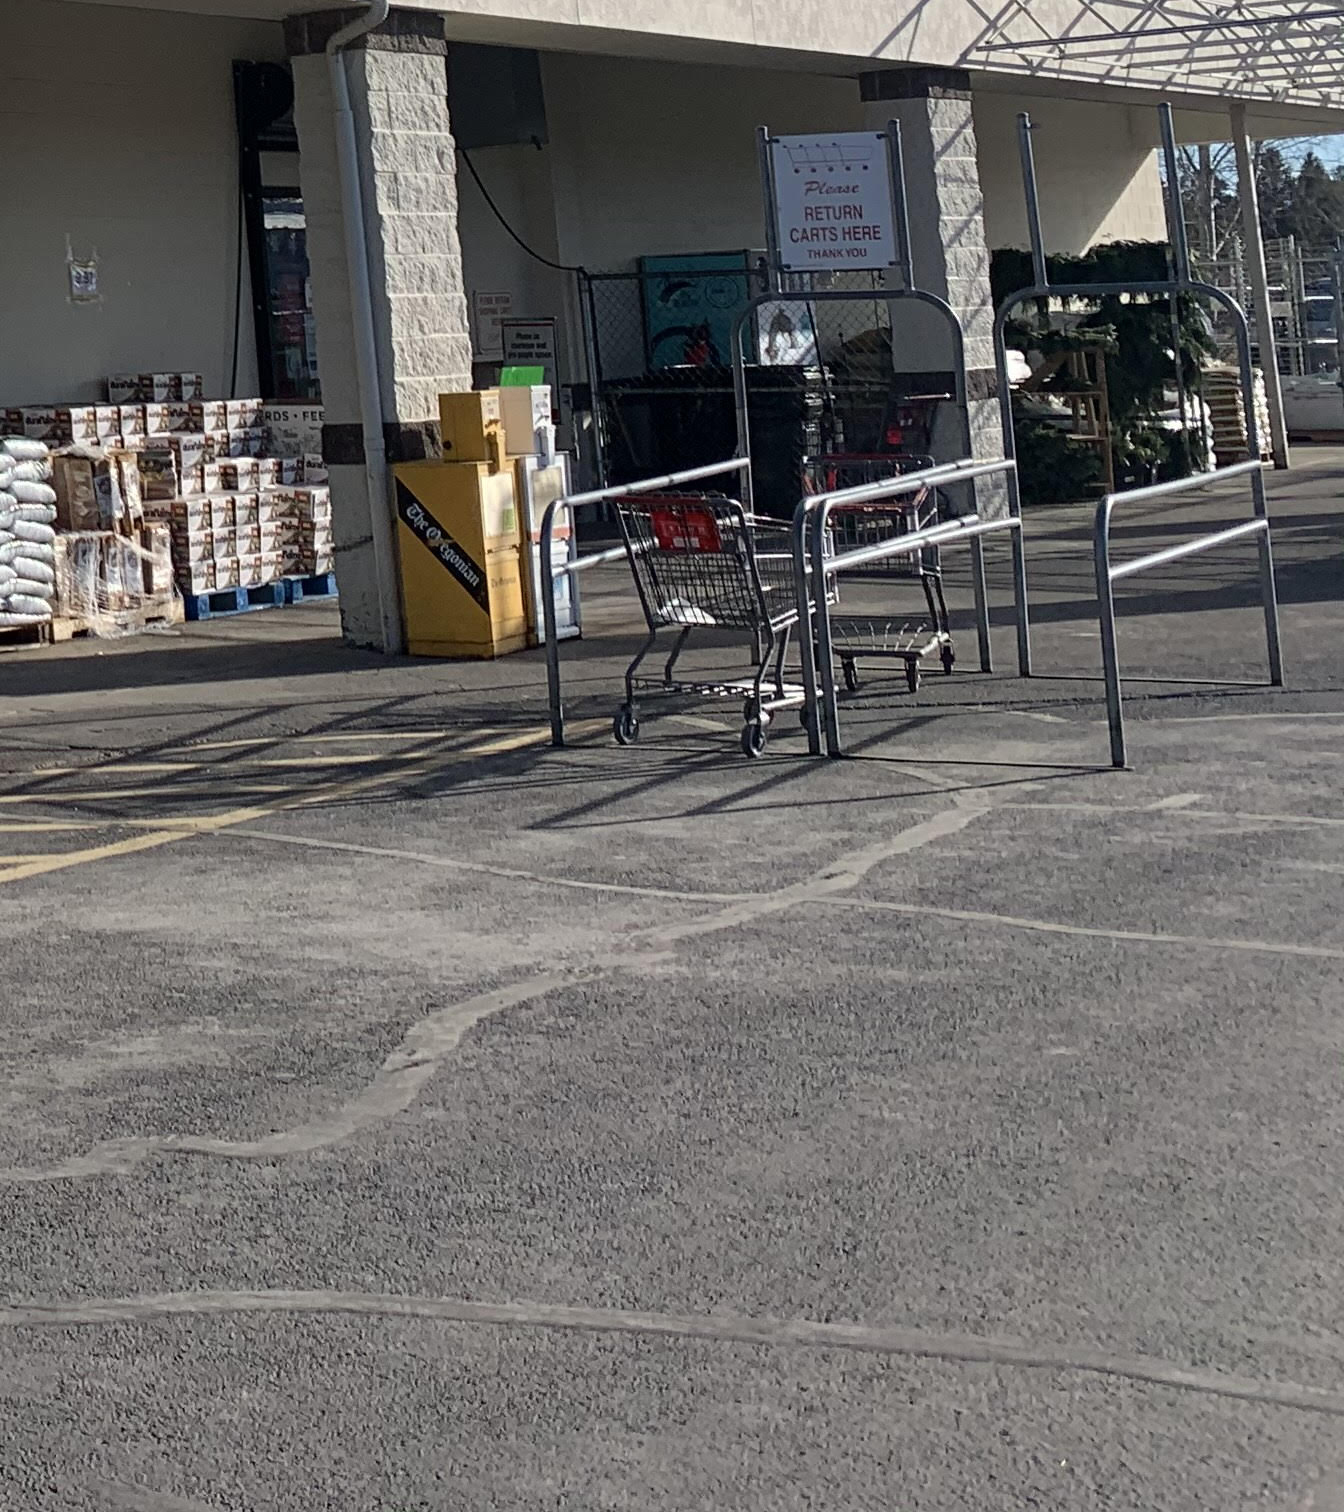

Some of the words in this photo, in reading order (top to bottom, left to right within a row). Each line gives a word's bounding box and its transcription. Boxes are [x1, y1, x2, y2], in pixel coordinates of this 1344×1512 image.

[804, 180, 859, 197] Please
[805, 204, 863, 221] RETURN
[790, 226, 838, 243] CARTS
[842, 225, 881, 241] HERE
[807, 249, 844, 259] THANK
[846, 248, 867, 258] YOU
[263, 411, 289, 422] RDS
[302, 411, 326, 422] FEE
[406, 503, 429, 531] The
